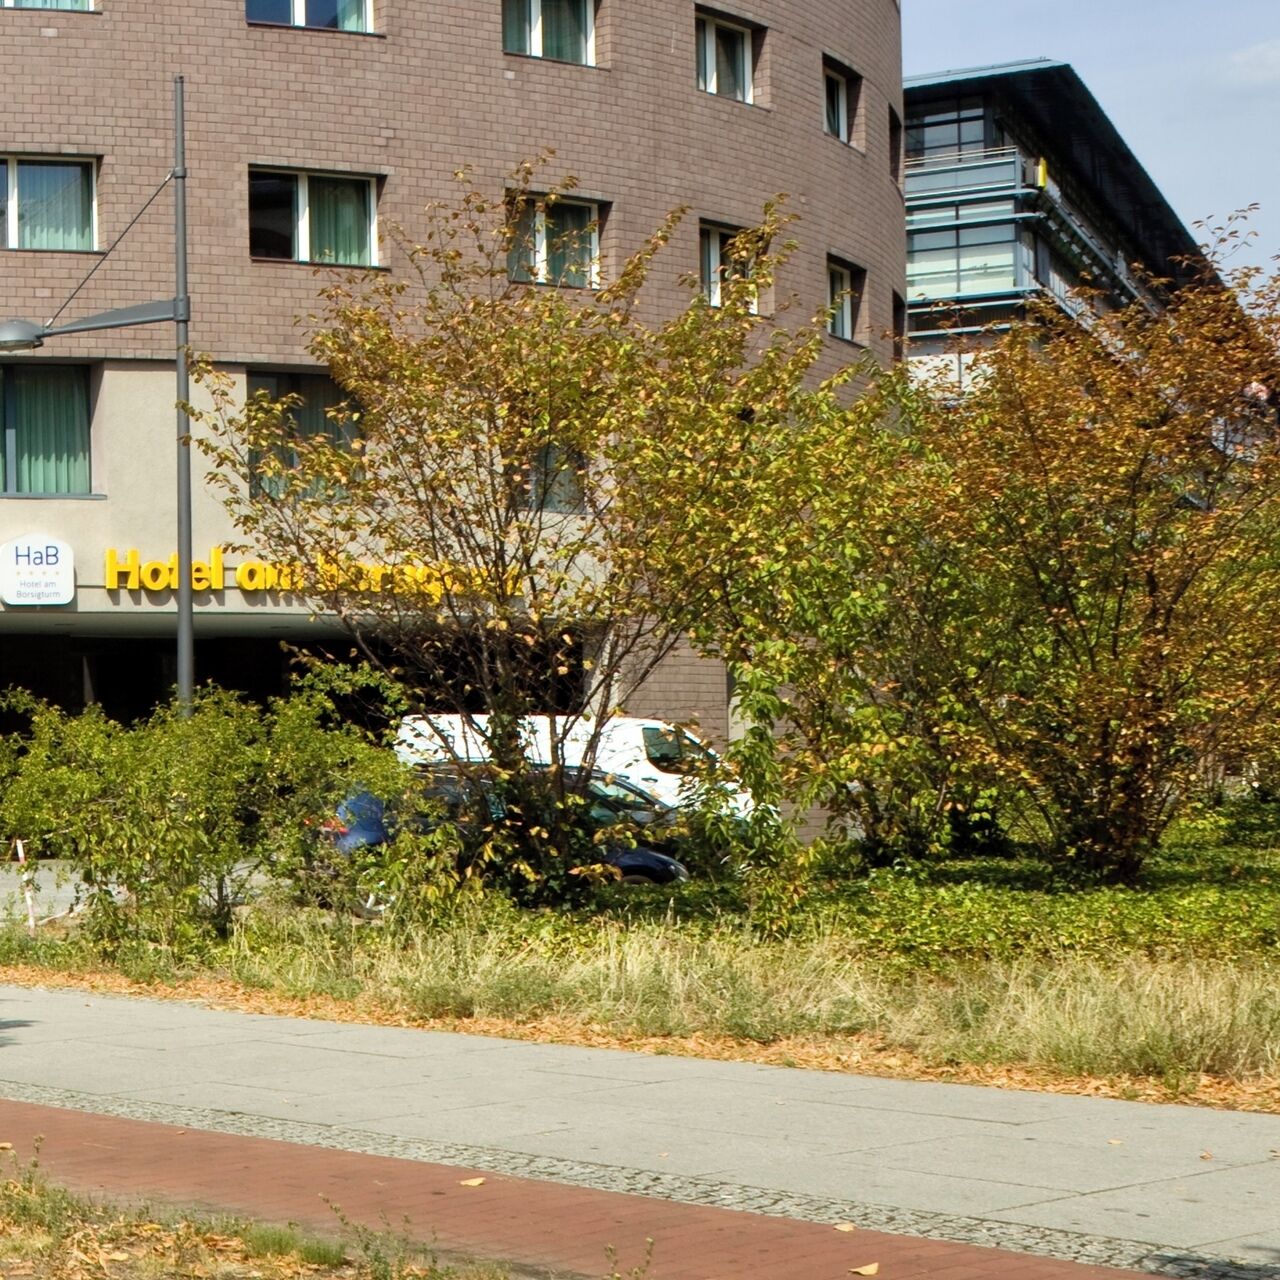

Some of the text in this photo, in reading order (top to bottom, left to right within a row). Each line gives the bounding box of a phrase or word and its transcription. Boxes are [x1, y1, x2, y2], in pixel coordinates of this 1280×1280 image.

[15, 545, 59, 566] HaB
[105, 548, 224, 590] Hotel
[20, 580, 42, 588] Hotel
[16, 590, 61, 600] Borsigturm
